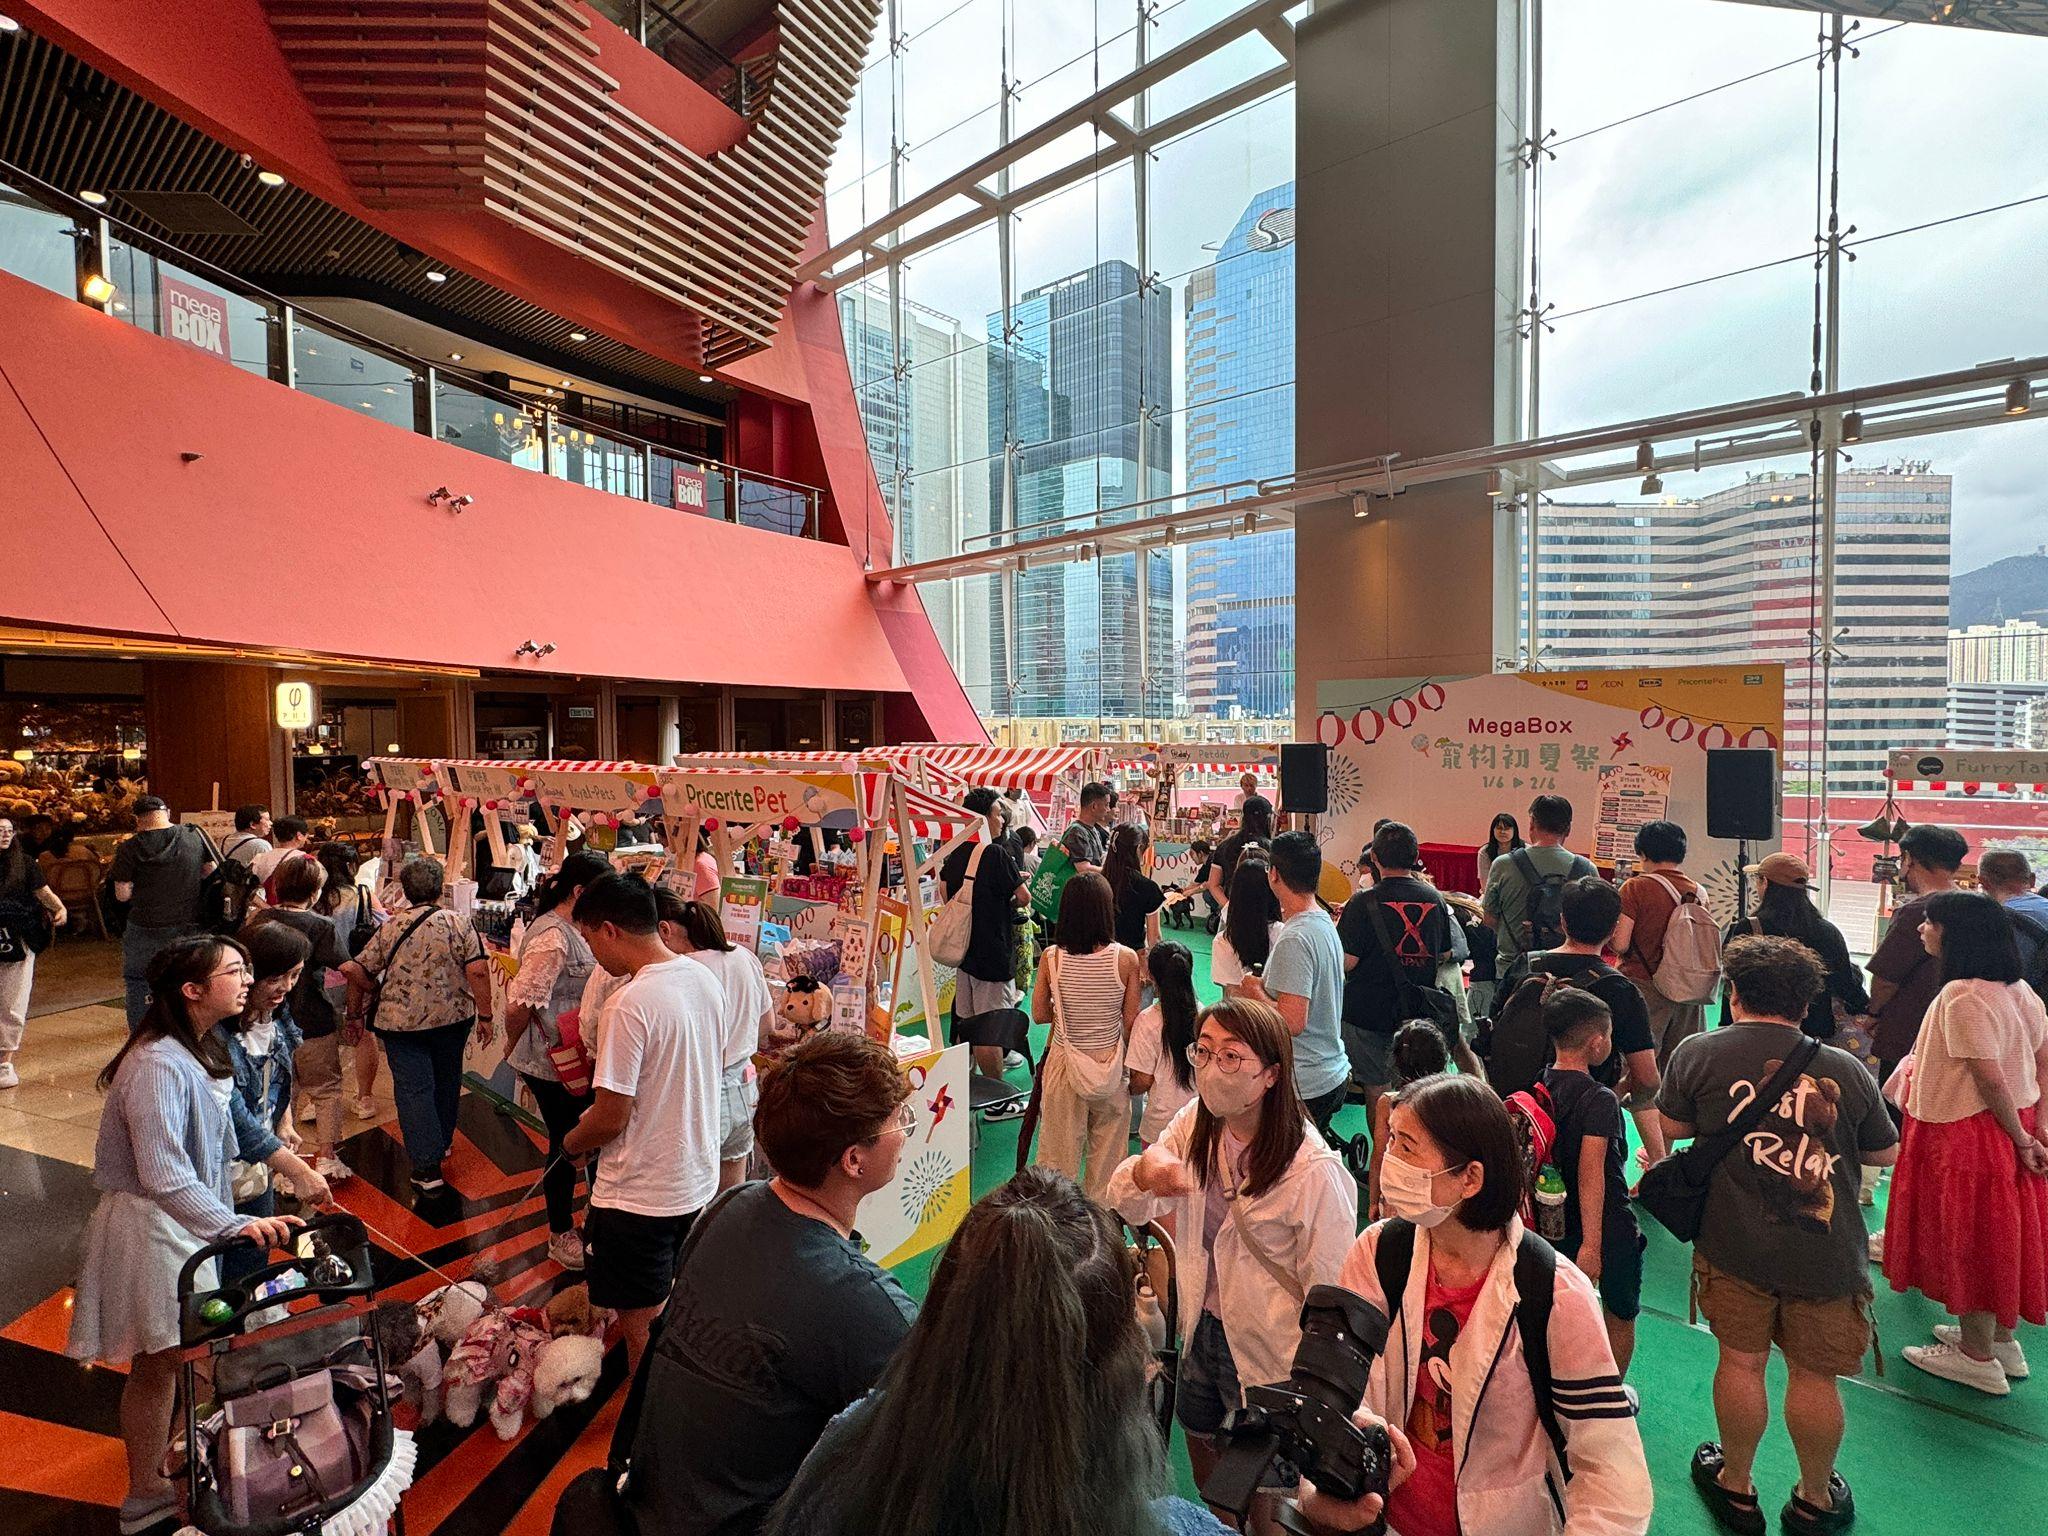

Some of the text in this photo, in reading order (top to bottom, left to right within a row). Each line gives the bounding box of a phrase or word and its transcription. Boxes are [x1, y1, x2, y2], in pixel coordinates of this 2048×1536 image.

[170, 289, 221, 324] mega
[171, 304, 224, 355] BOX
[677, 475, 703, 489] mega
[678, 483, 704, 508] BOX
[1468, 717, 1573, 738] MegaBox
[685, 783, 790, 814] PriceritePet
[1482, 775, 1556, 790] 1/6 2/6
[1382, 901, 1438, 958] X
[1726, 1078, 1819, 1128] Jst
[1743, 1131, 1841, 1180] Relax
